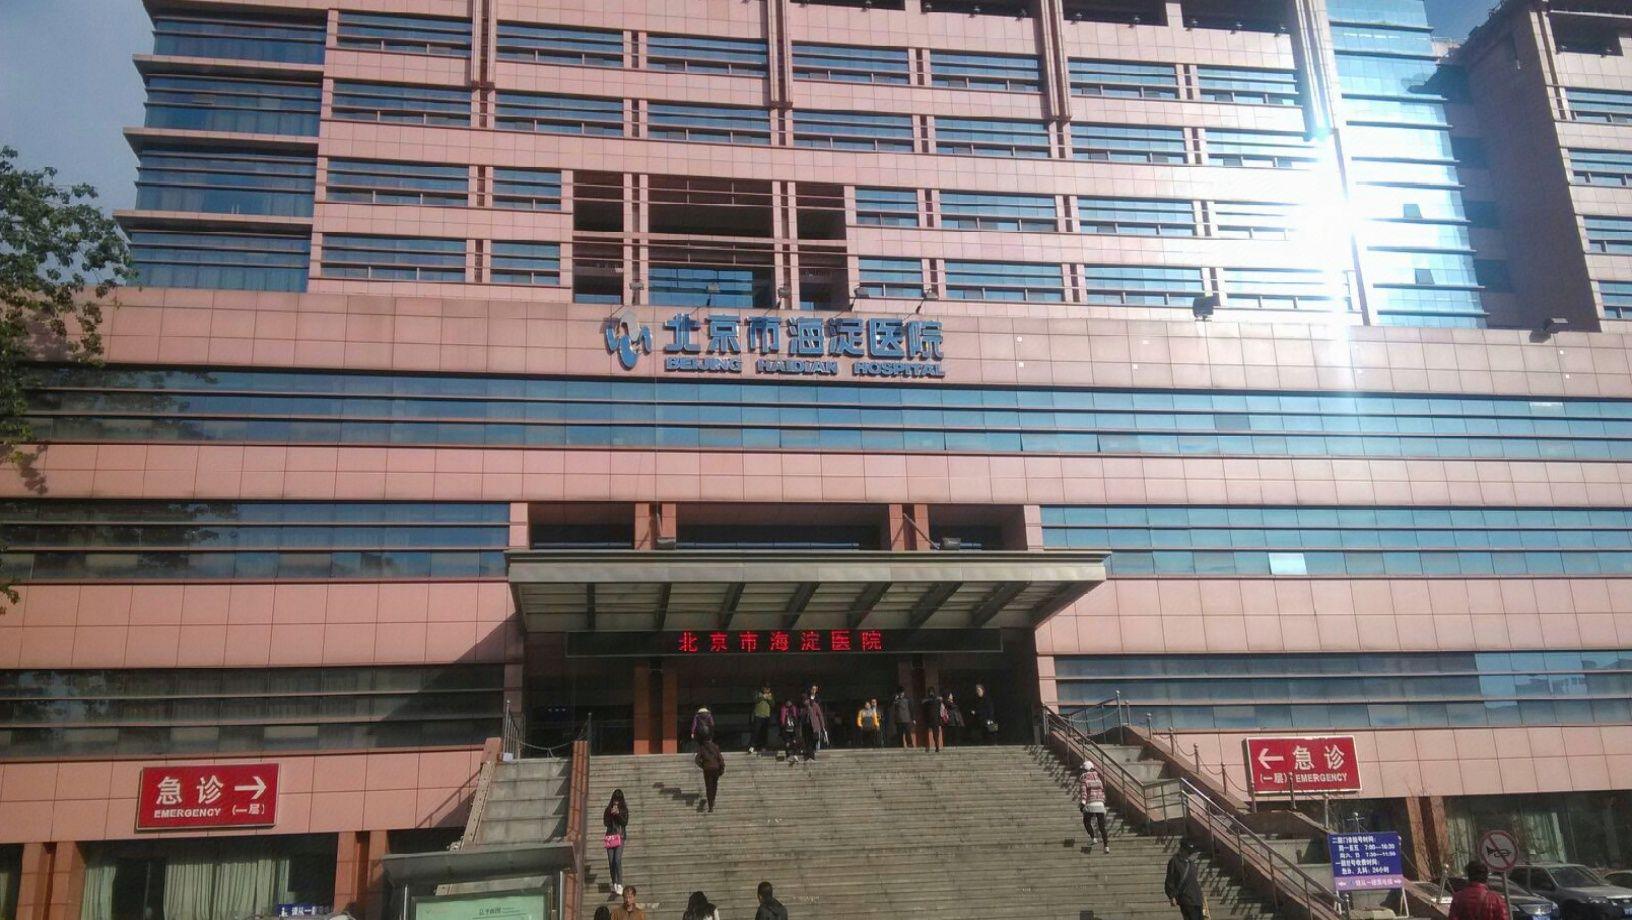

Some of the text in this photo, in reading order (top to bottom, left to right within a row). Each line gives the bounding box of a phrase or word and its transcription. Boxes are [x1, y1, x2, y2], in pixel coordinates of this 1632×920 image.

[664, 313, 943, 359] 北京市海淀医院
[665, 357, 945, 377] BEIJING HAIDIAN HOSPITAL
[678, 631, 882, 653] 北京市海淀医院
[1292, 744, 1344, 770] 急诊
[1296, 772, 1348, 783] EMERGENCY
[155, 775, 224, 804] 急诊
[153, 808, 222, 819] EMERGENCY
